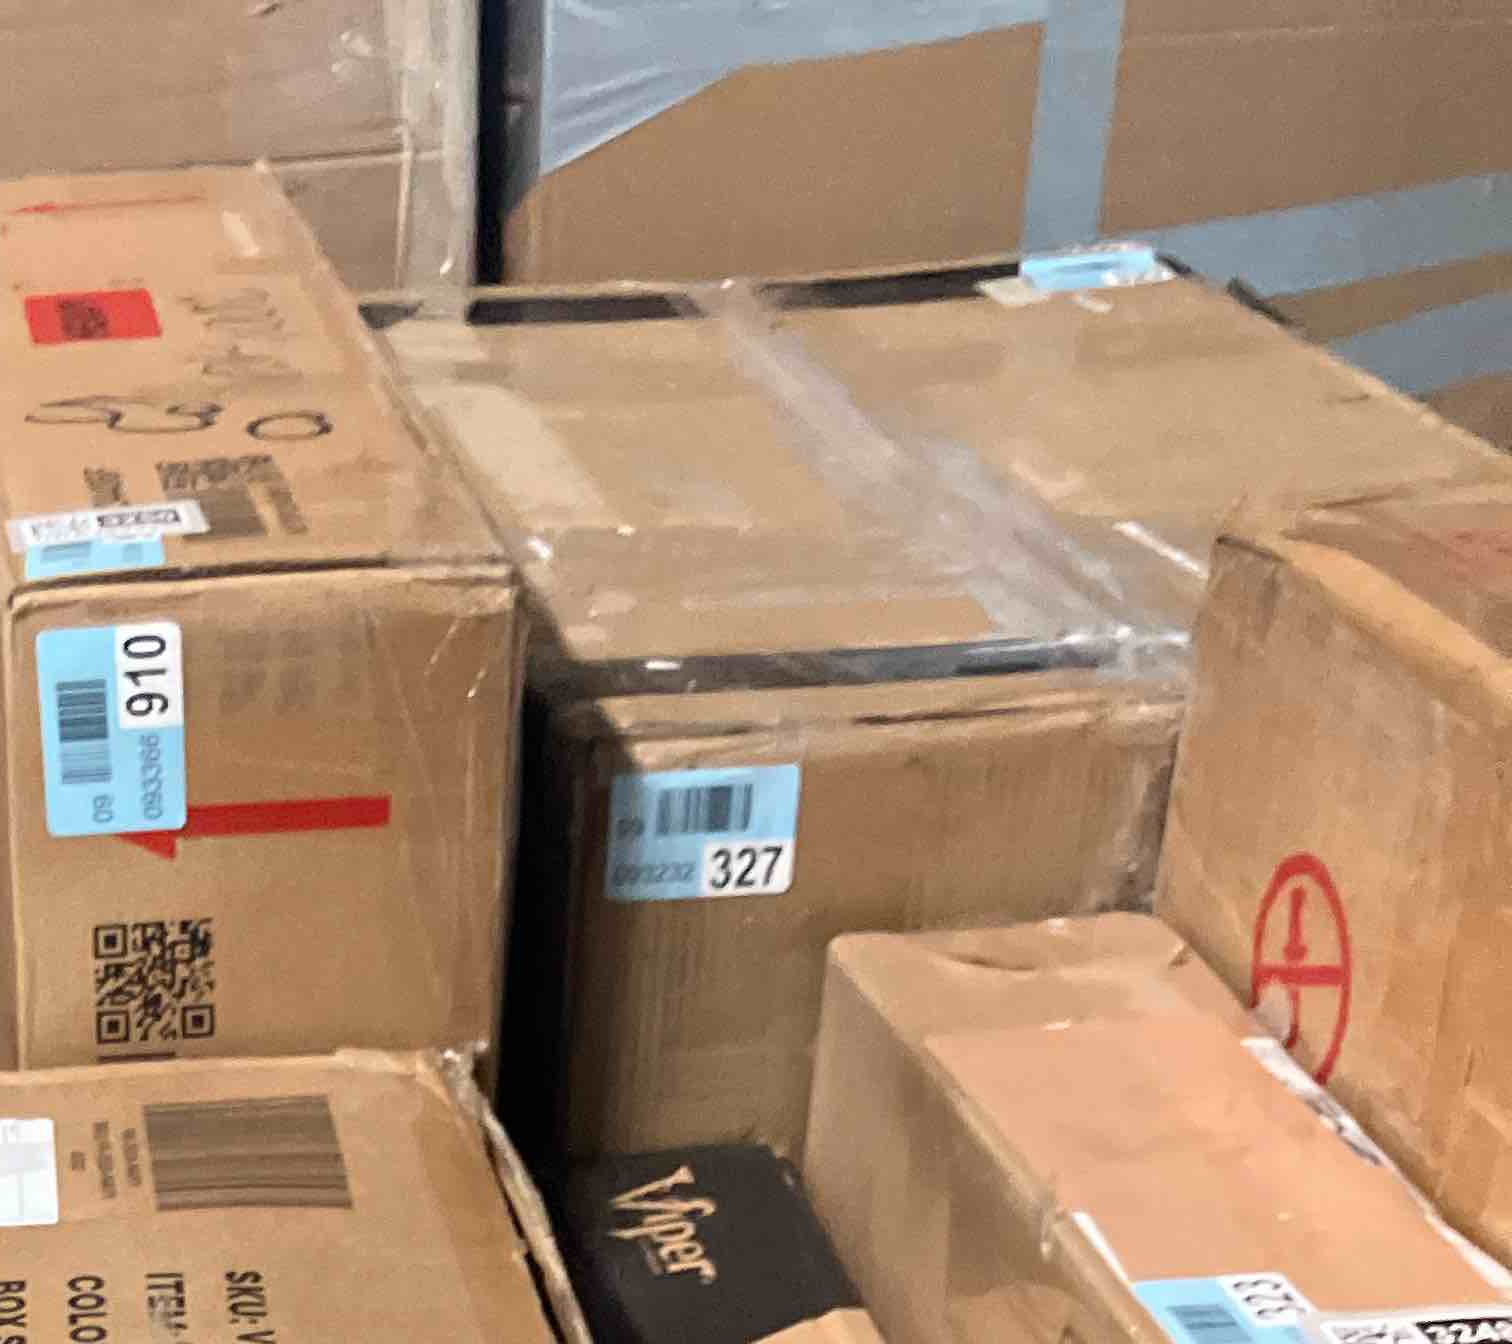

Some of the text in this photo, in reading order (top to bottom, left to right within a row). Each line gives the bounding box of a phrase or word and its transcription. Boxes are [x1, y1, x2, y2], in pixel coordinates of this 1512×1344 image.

[122, 634, 170, 719] 910
[710, 846, 783, 889] 327
[607, 1165, 717, 1284] Viper
[225, 1272, 268, 1324] SKU:
